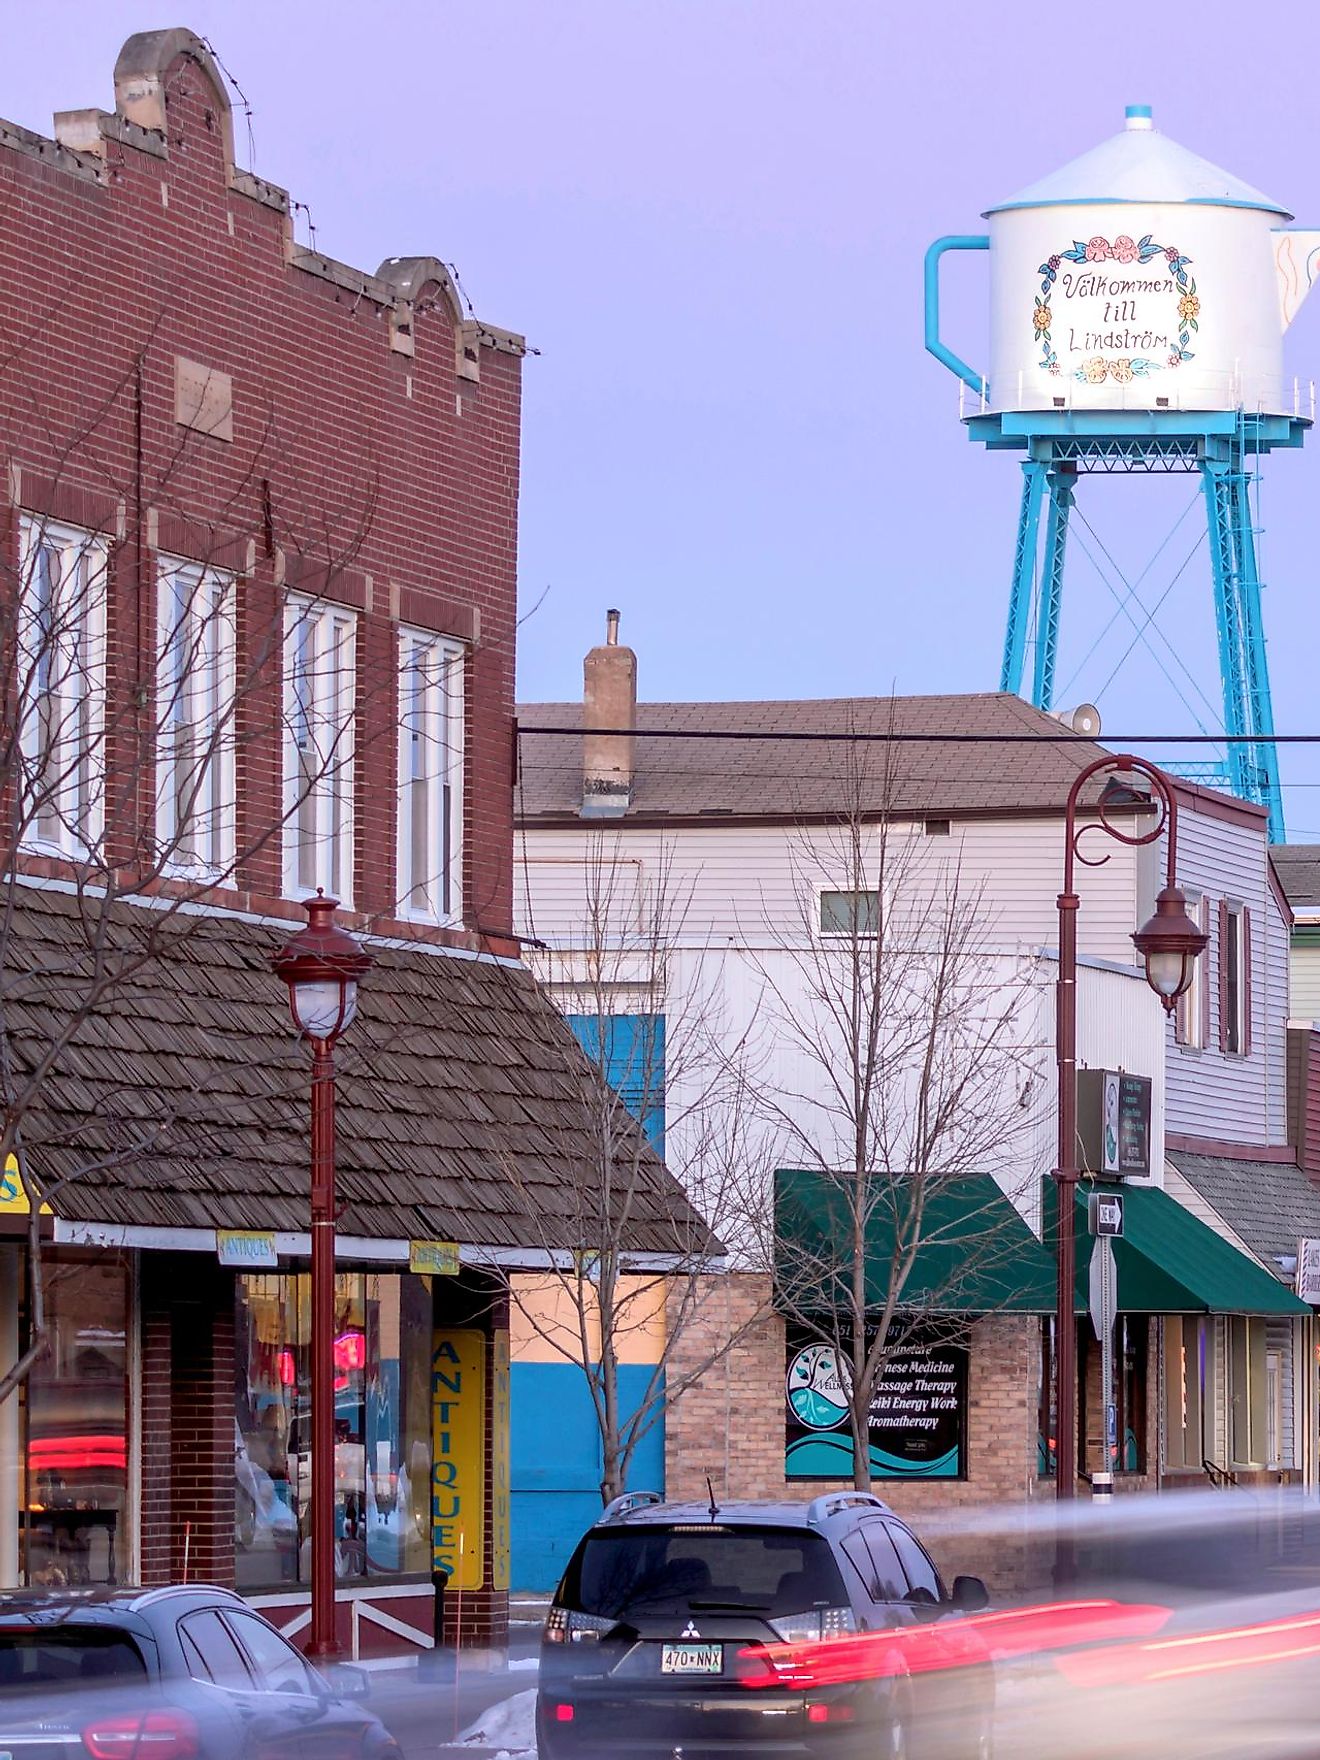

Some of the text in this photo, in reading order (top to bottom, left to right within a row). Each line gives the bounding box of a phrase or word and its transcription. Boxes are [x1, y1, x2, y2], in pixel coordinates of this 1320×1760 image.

[1103, 301, 1136, 322] till
[1069, 328, 1167, 351] Lindström
[226, 1237, 269, 1259] ANTIQUES
[909, 1361, 955, 1374] Medicine
[871, 1380, 957, 1394] assage Therapy
[892, 1397, 929, 1412] Energy
[930, 1397, 957, 1410] Work
[431, 1341, 461, 1578] ANTIQUES
